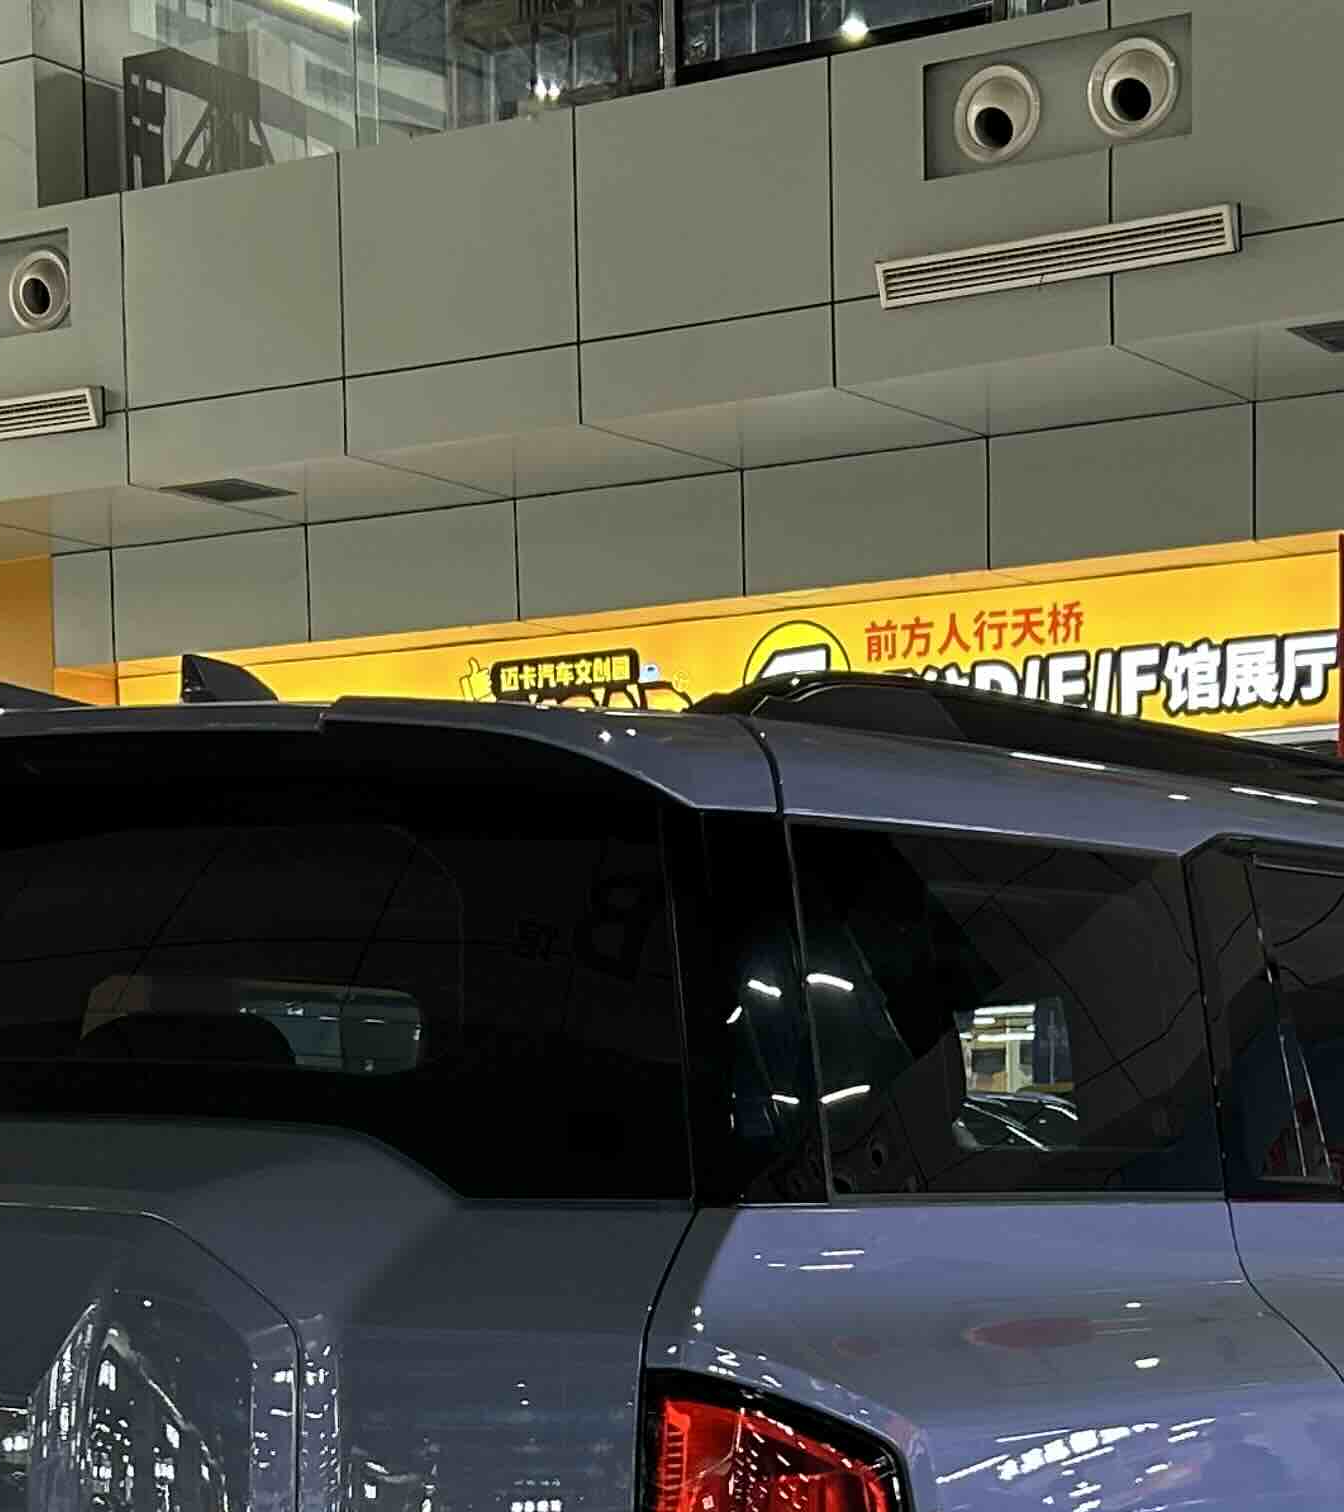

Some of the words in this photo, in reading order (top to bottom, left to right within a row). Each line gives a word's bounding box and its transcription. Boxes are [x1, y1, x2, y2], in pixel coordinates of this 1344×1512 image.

[865, 600, 1084, 662] 前方人行天桥
[878, 634, 1339, 718] D/E/F馆展厅
